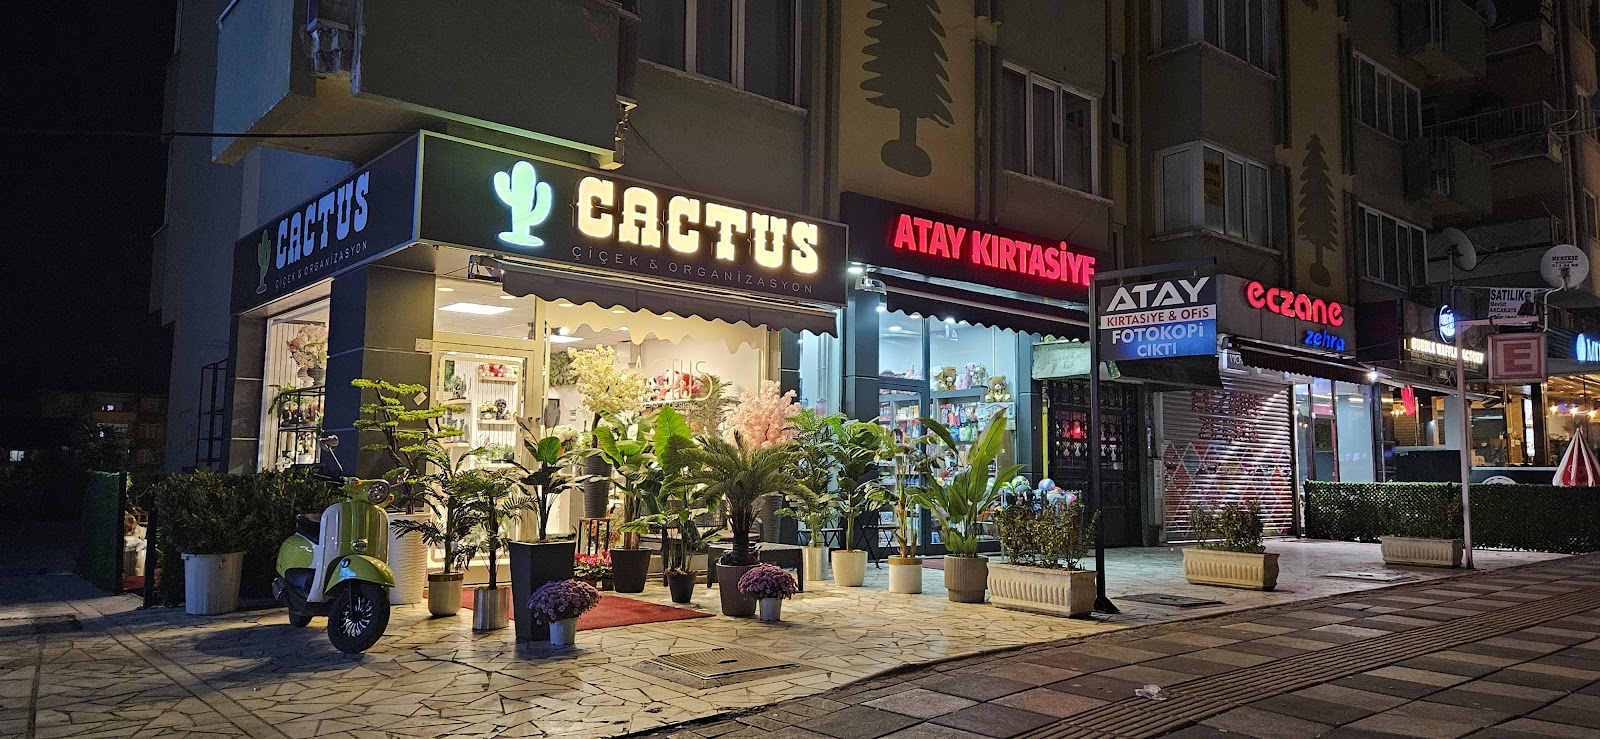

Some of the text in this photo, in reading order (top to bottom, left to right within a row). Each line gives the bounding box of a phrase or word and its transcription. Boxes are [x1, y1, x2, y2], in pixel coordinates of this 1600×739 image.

[276, 171, 370, 270] CACTUS
[576, 176, 819, 275] CACTUS
[894, 213, 1096, 286] ATAY KIRTASİYE
[274, 241, 367, 292] ÇİÇEK & ORGANİZASYON
[571, 246, 814, 294] ÇİÇEK & ORGANİZASYON
[1106, 276, 1210, 312] ATAY
[1246, 281, 1345, 327] eczane
[1490, 289, 1525, 301] SATILIK
[1107, 307, 1210, 327] KIRTASİYE & OFİS
[1112, 322, 1204, 345] FOTOKOPİ
[1137, 342, 1177, 358] ÇIKTI
[1304, 329, 1346, 352] zehra
[1462, 348, 1484, 364] ACTORY
[1503, 342, 1533, 373] E
